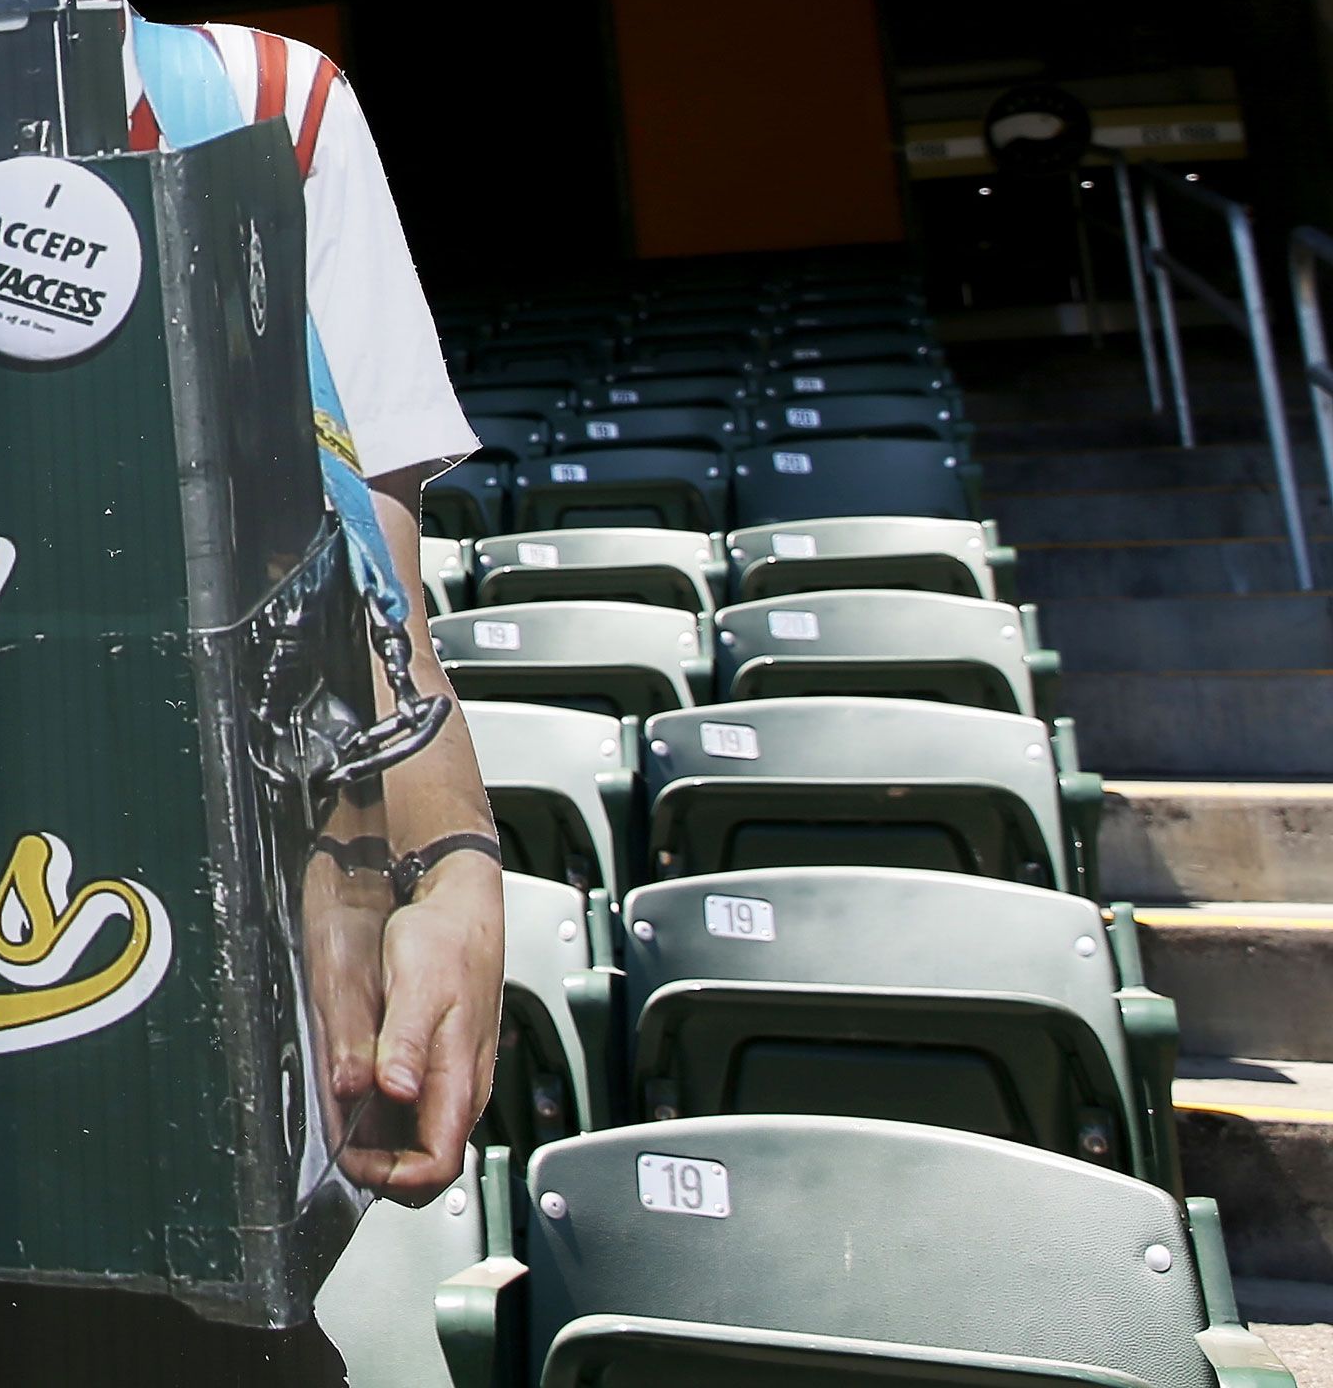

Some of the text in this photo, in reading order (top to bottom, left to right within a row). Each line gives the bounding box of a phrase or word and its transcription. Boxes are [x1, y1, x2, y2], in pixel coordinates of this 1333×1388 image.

[45, 184, 61, 209] I
[487, 625, 506, 645] 19
[716, 728, 741, 753] 19
[724, 900, 753, 935] 19
[660, 1159, 704, 1210] 19
